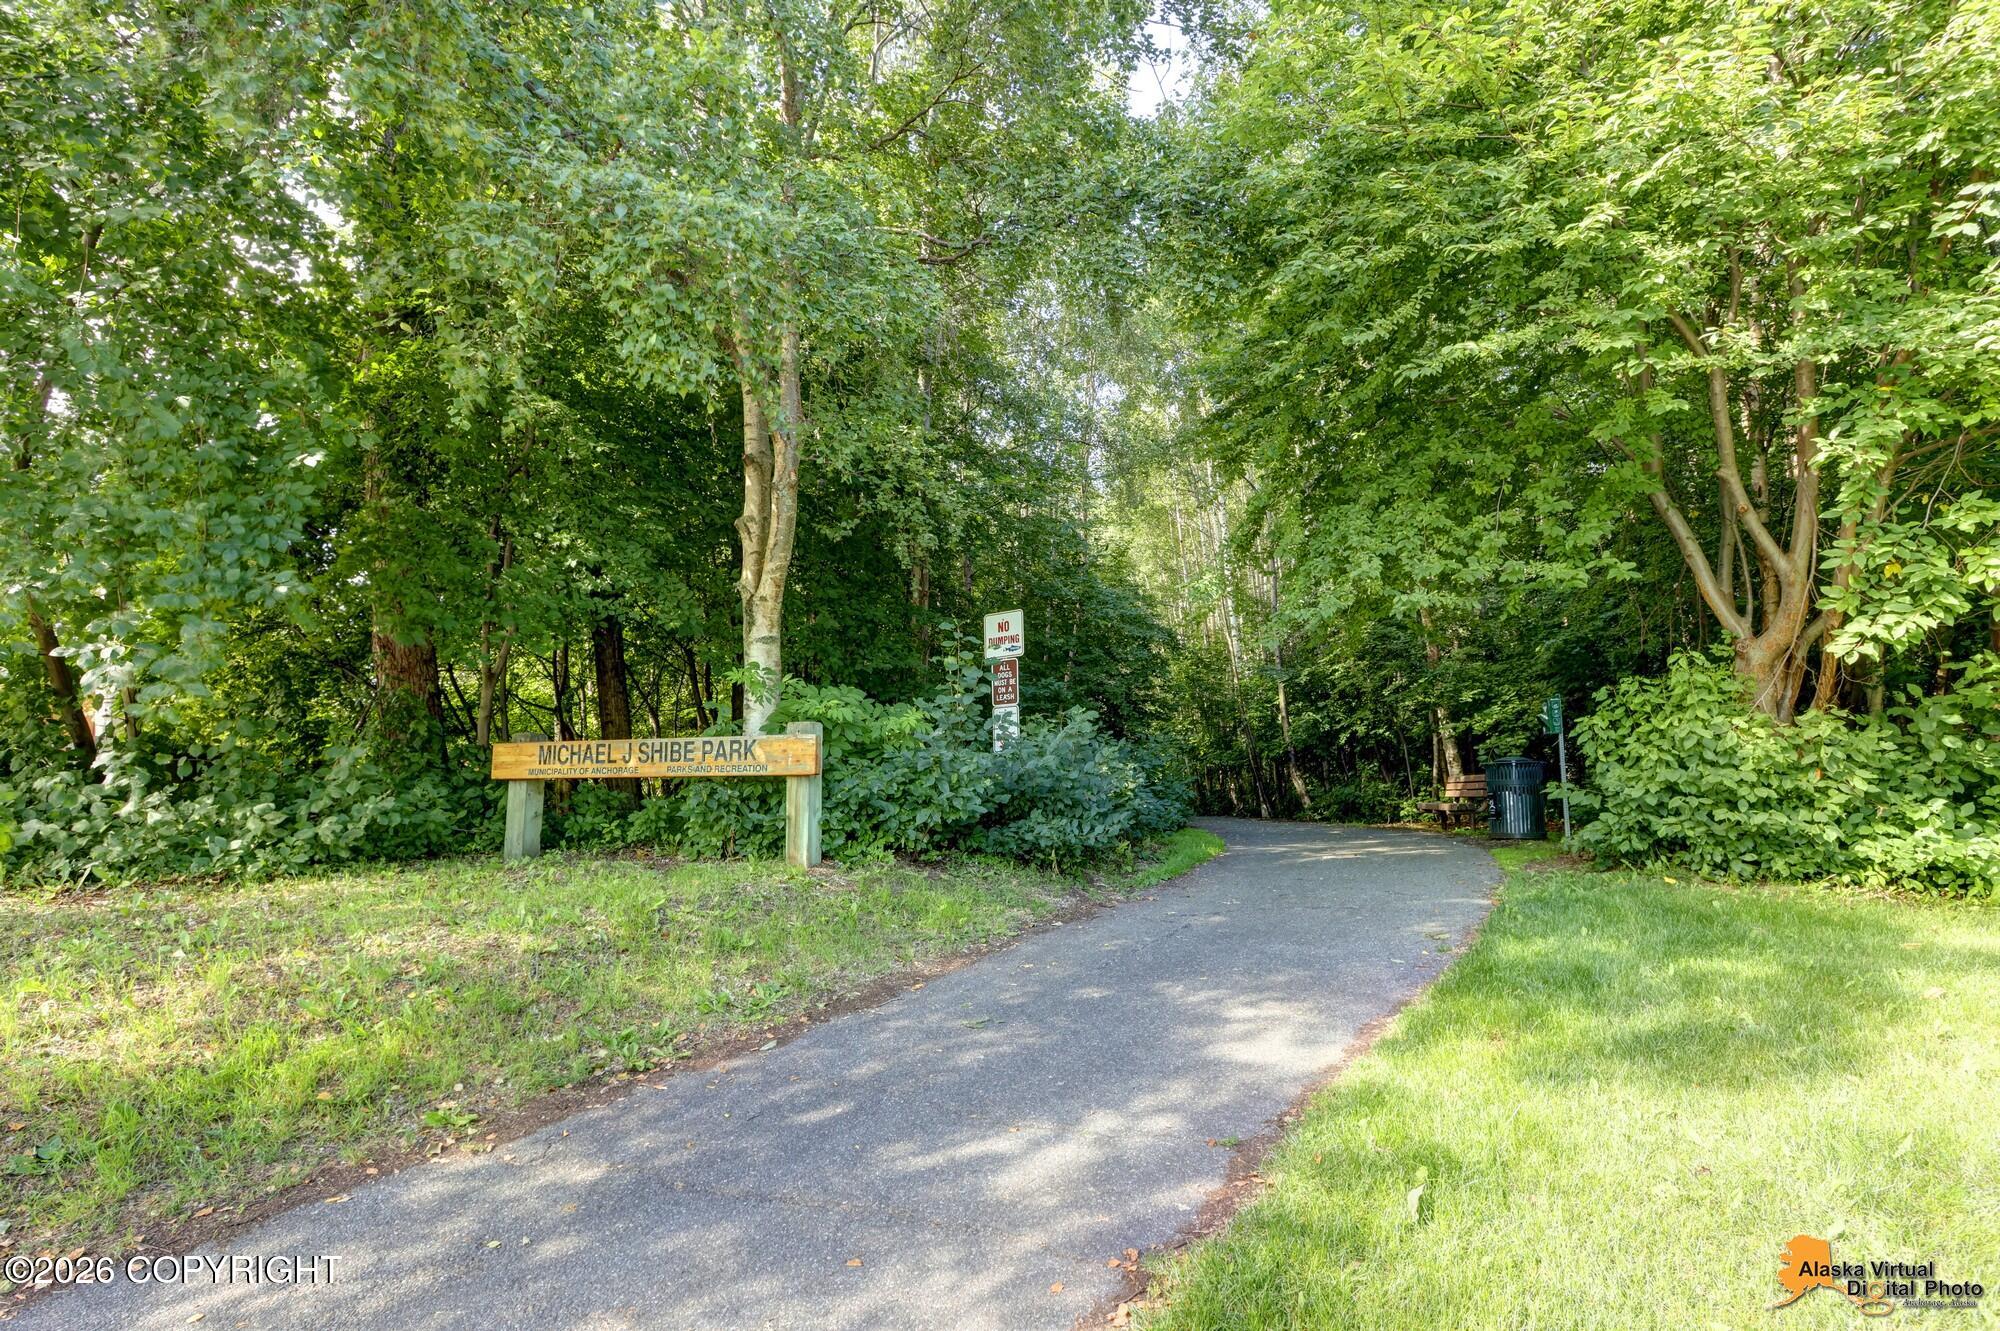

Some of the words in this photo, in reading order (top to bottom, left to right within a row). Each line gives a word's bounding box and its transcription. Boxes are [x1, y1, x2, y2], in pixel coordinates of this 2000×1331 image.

[998, 620, 1010, 632] NO
[988, 634, 1020, 645] DUMPING
[996, 693, 1014, 701] LEASH
[538, 743, 617, 765] MICHAEL
[622, 742, 632, 764] J
[638, 741, 695, 764] SHIBE
[702, 740, 756, 762] PARK
[592, 766, 639, 774] ANCHORAGE
[715, 764, 768, 772] RECREATION
